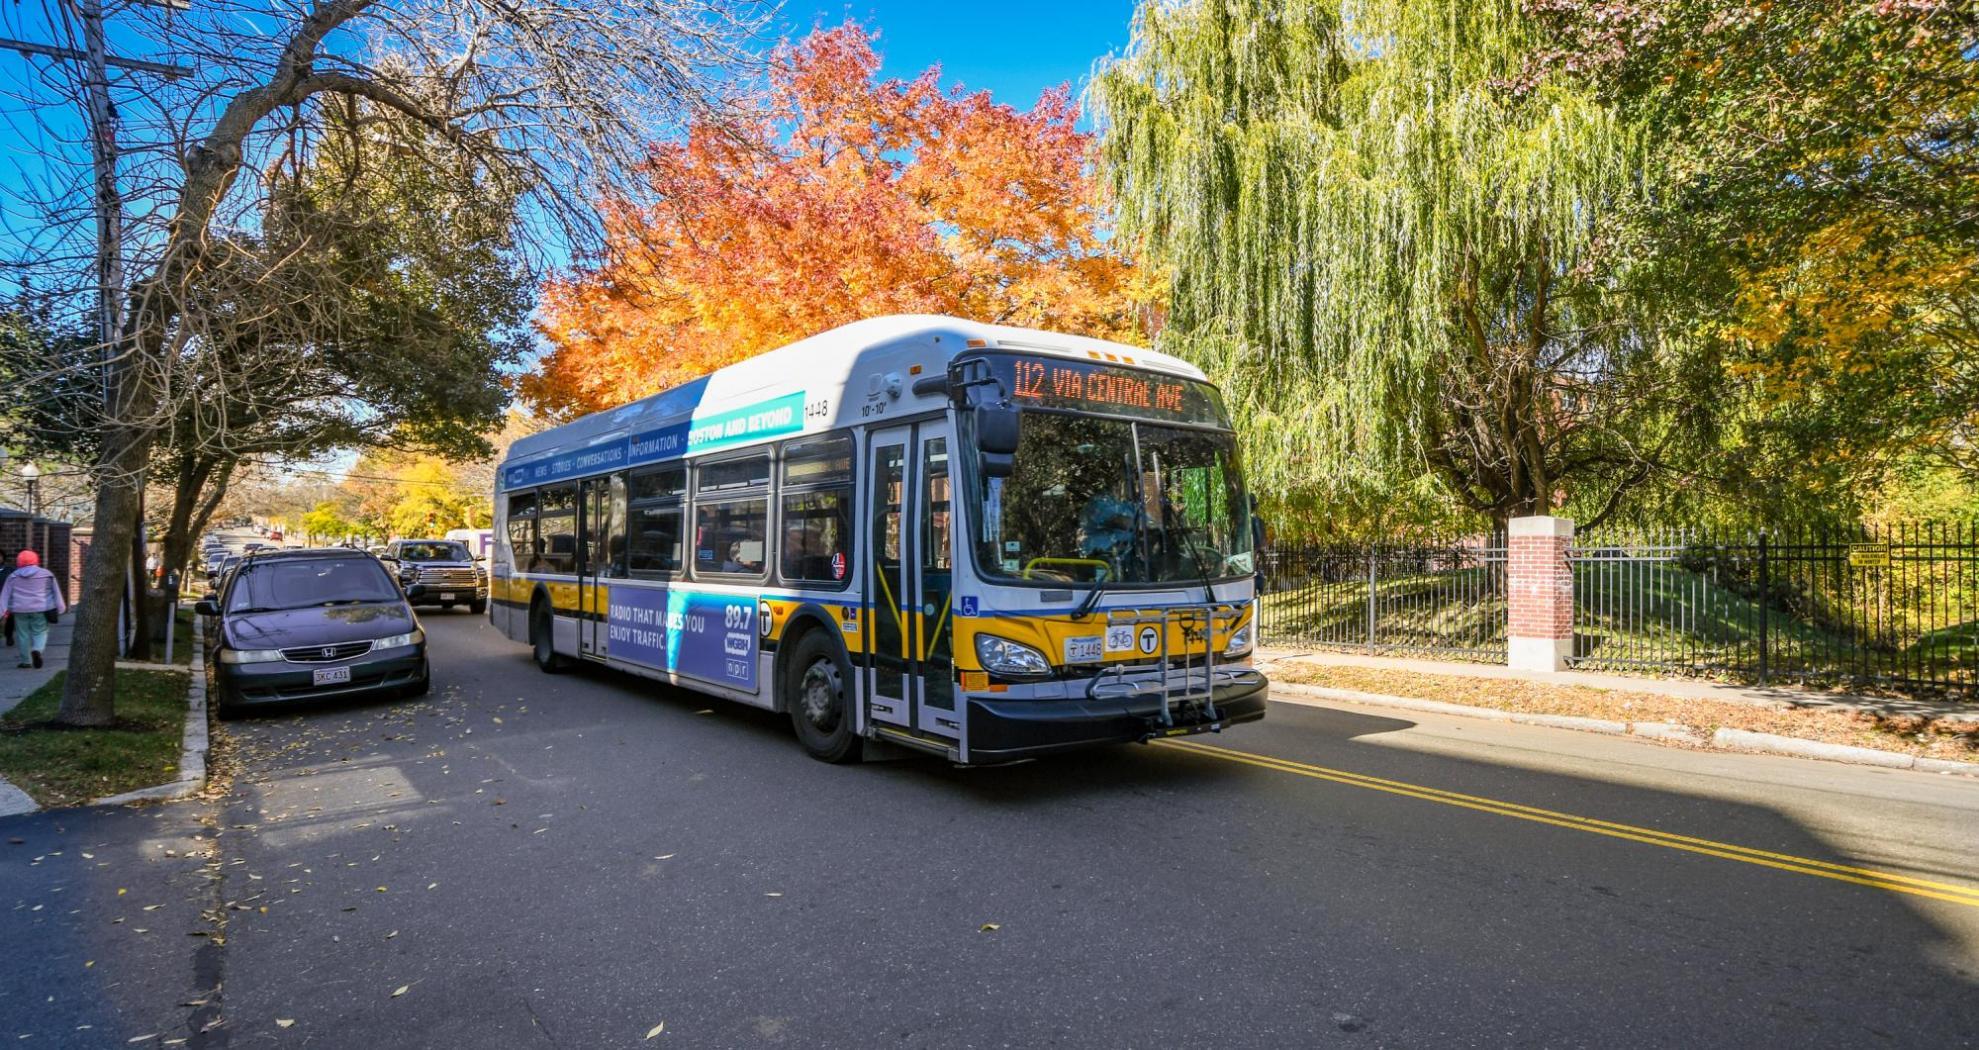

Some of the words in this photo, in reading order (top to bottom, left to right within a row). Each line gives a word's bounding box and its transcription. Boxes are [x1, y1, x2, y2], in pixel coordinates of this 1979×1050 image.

[1014, 361, 1045, 399] 112
[1053, 368, 1082, 399] VIA
[1087, 373, 1150, 408] CENTRAL
[1156, 384, 1184, 412] AVE
[805, 400, 827, 419] 1448
[576, 447, 622, 469] CONVERSATIONS
[628, 434, 678, 457] INFORMATION
[687, 423, 723, 446] BOSTON
[724, 418, 746, 437] AND
[747, 406, 792, 433] BEYOND
[610, 604, 631, 621] RADIO
[633, 607, 653, 624] THAT
[655, 610, 684, 631] MAKES
[685, 614, 705, 633] YOU
[724, 604, 752, 630] 89.7
[609, 625, 631, 641] ENJOY
[632, 629, 666, 650] TRAFFIC.
[1080, 643, 1101, 657] 1448
[728, 663, 746, 676] npr
